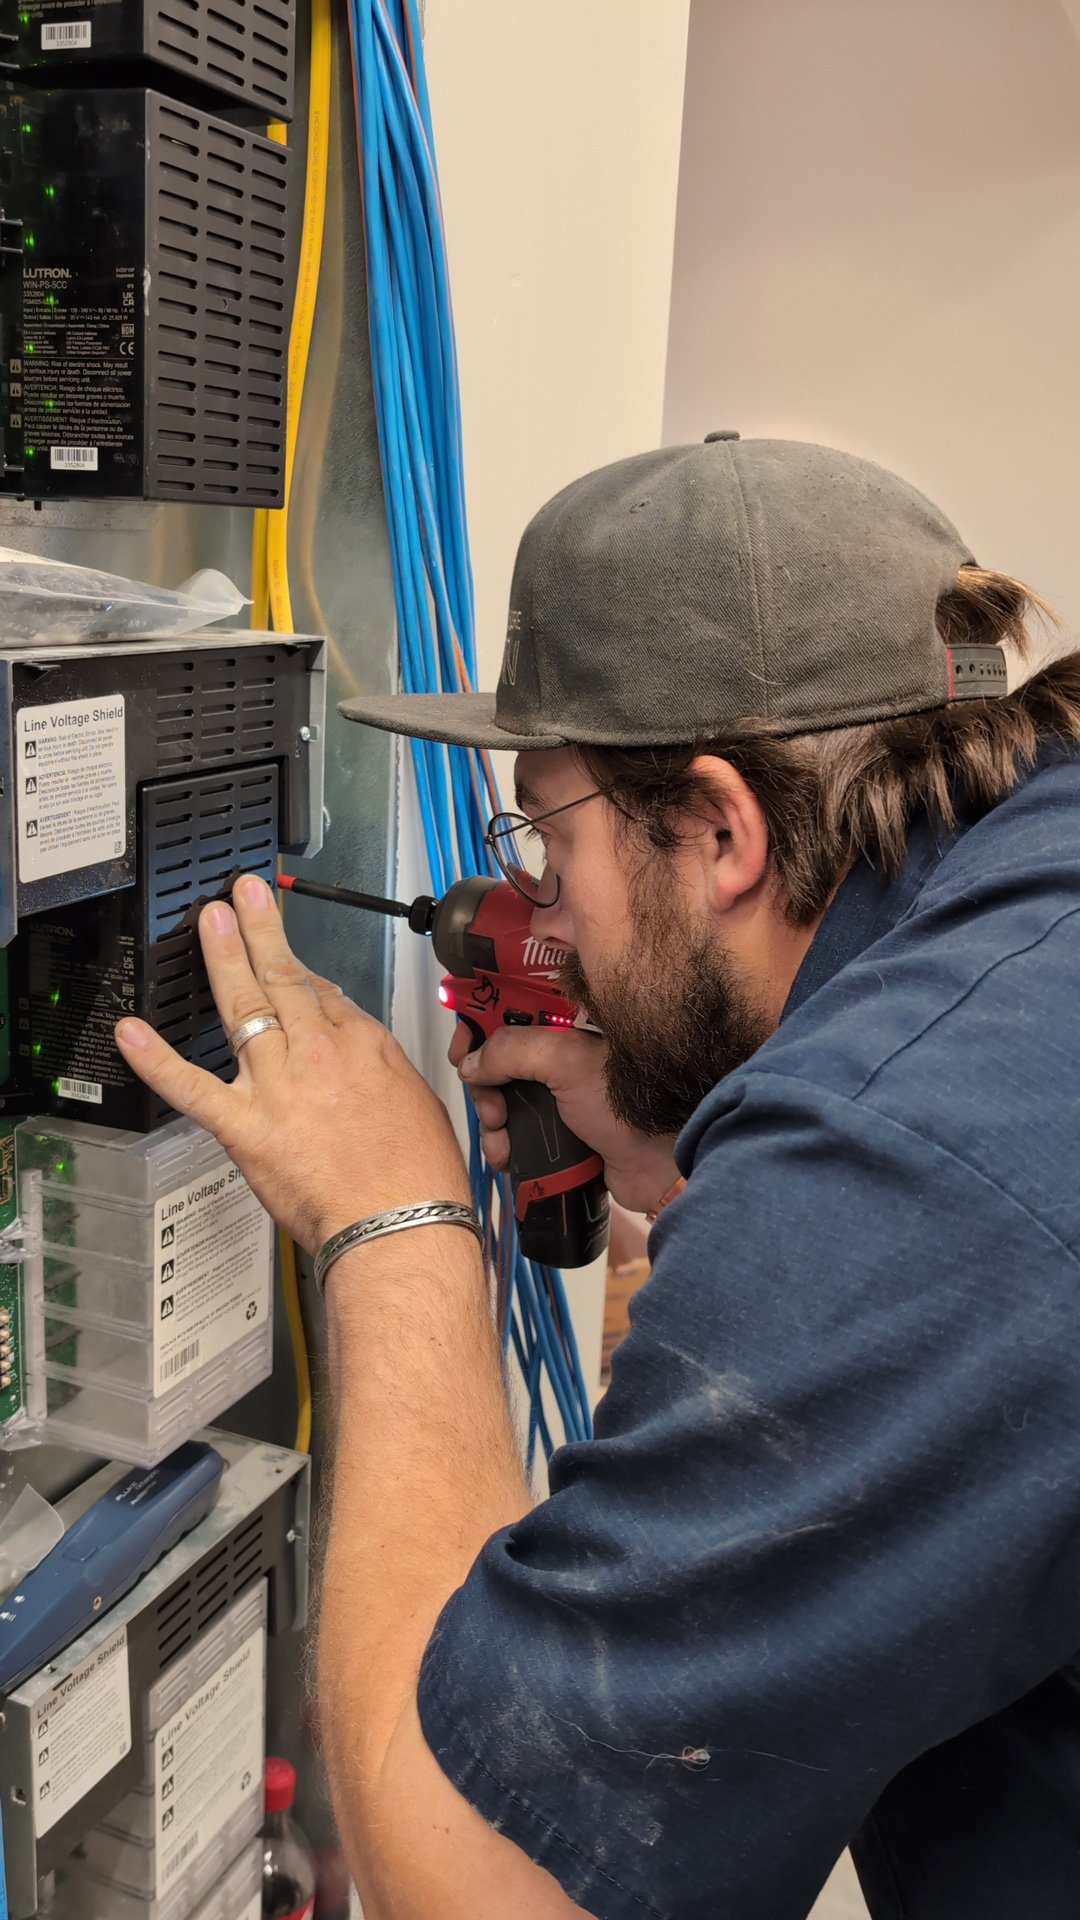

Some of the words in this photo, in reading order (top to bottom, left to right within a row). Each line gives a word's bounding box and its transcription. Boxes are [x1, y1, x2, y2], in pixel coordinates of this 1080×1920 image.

[23, 281, 68, 289] WIN-PS-5CC
[24, 720, 47, 732] Line
[50, 714, 90, 728] Voltage
[93, 706, 123, 722] Shield
[162, 1201, 185, 1221] Line
[188, 1178, 226, 1205] Voltage
[38, 1696, 58, 1720] Line
[60, 1662, 95, 1698] Voltage
[98, 1634, 125, 1665] Shield
[162, 1720, 182, 1746] Line
[185, 1681, 221, 1720] Voltage
[223, 1647, 250, 1683] Shield
